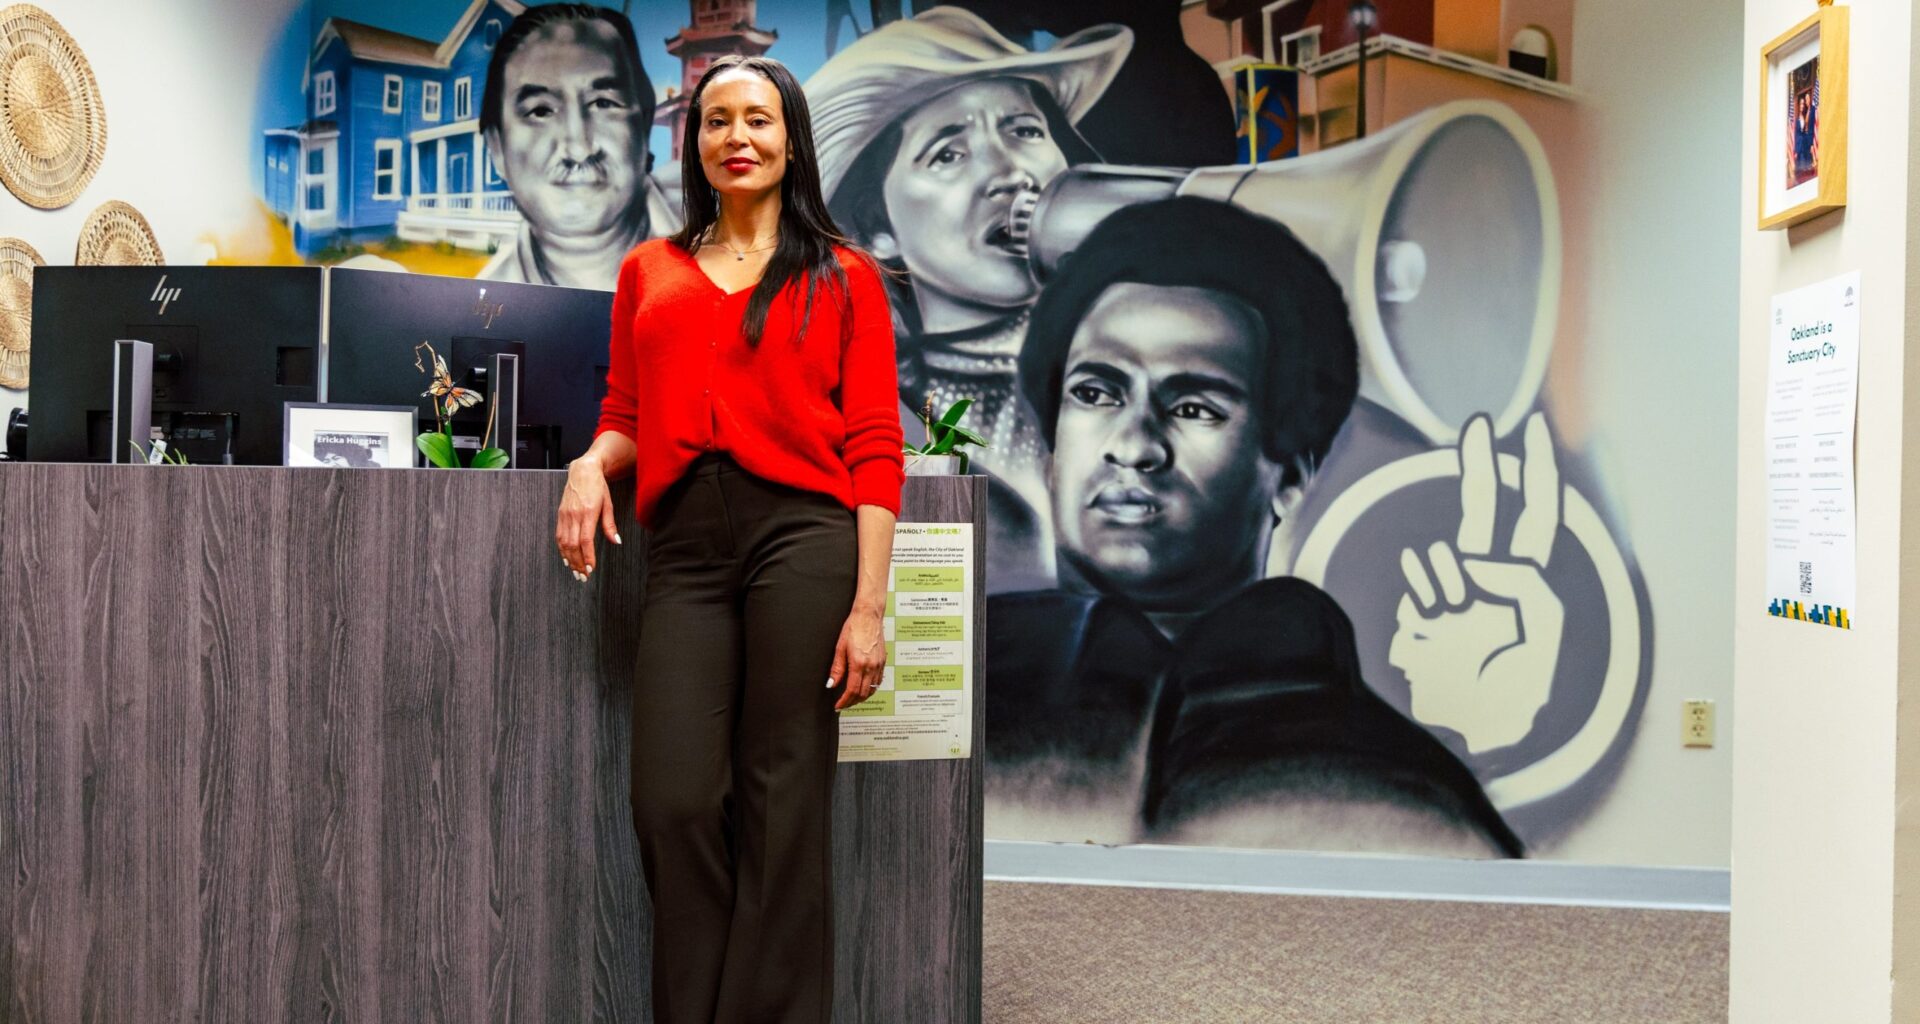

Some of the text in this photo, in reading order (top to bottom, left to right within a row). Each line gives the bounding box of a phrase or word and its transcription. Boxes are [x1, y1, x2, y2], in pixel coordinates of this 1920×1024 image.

[150, 274, 182, 316] hp
[1791, 320, 1819, 341] Oakland
[1820, 320, 1826, 334] is
[1827, 323, 1833, 333] a
[1787, 341, 1836, 364] Sanctuary City
[317, 435, 382, 447] Ericka Huggins
